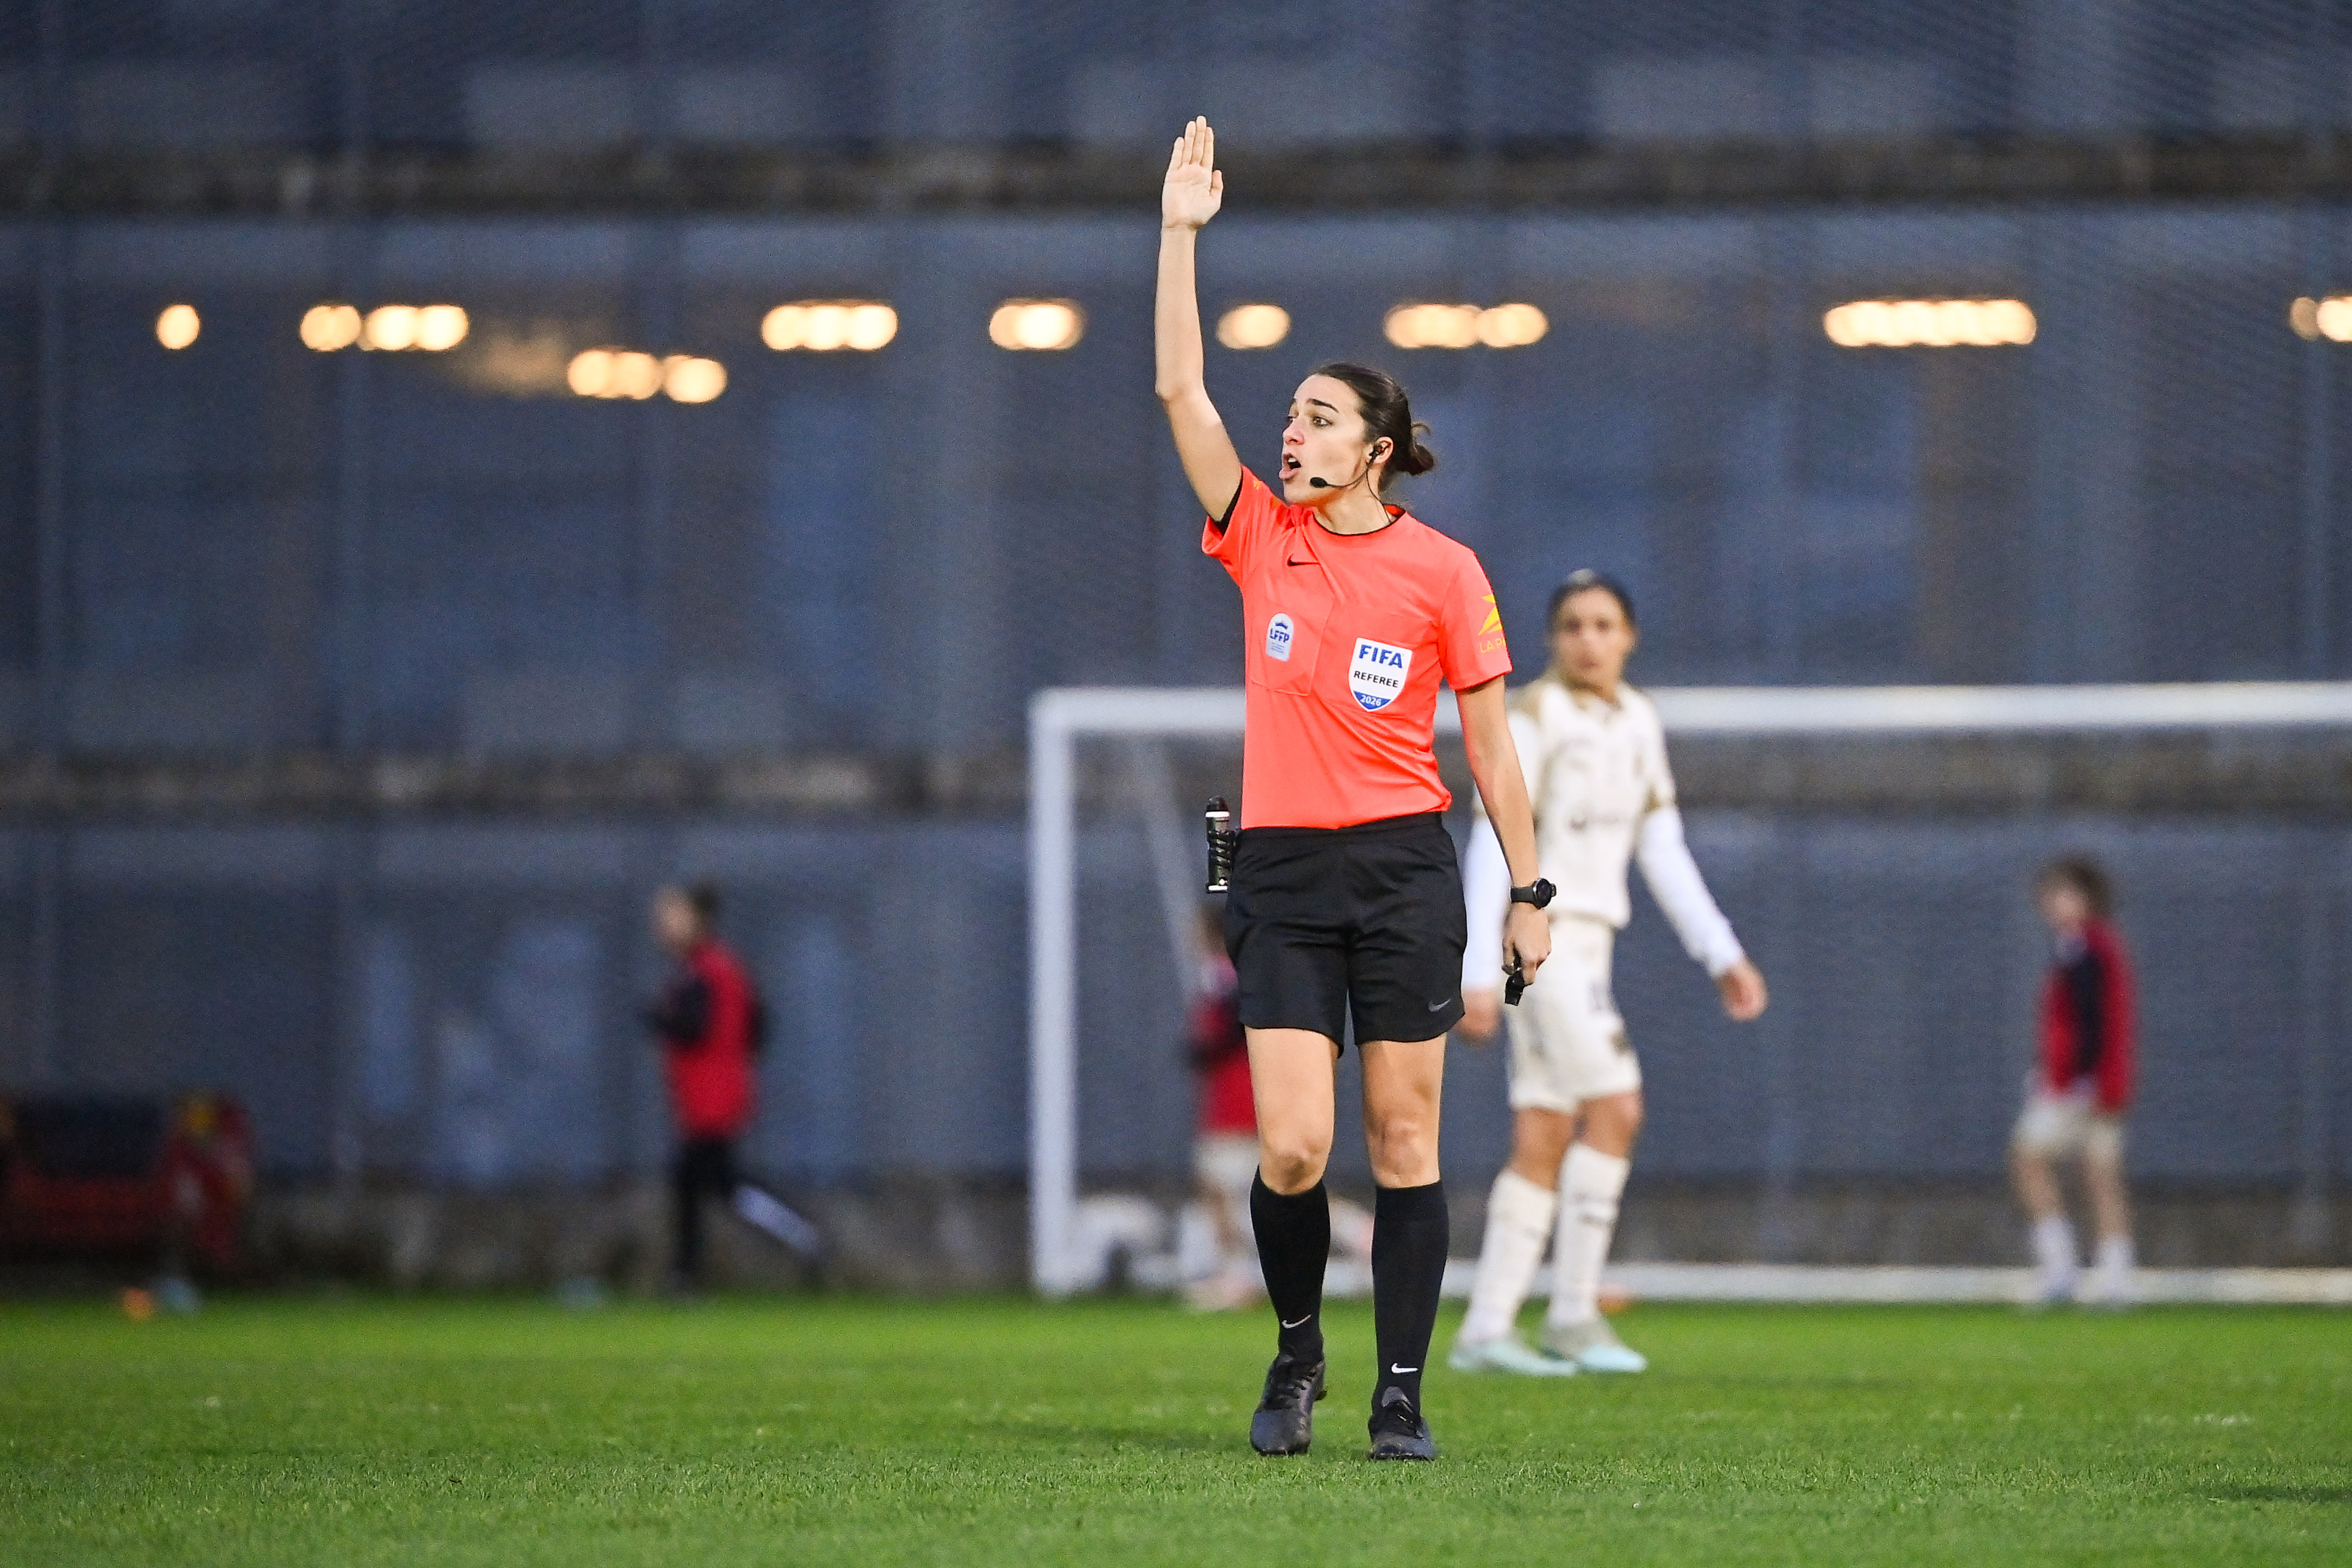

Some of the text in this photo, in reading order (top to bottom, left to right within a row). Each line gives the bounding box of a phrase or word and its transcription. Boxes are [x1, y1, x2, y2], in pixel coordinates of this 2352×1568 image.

[1269, 628, 1289, 643] LFFP
[1479, 640, 1495, 653] LA
[1359, 644, 1402, 669] FIFA
[1353, 670, 1399, 688] REFEREE
[1360, 695, 1382, 706] 2026
